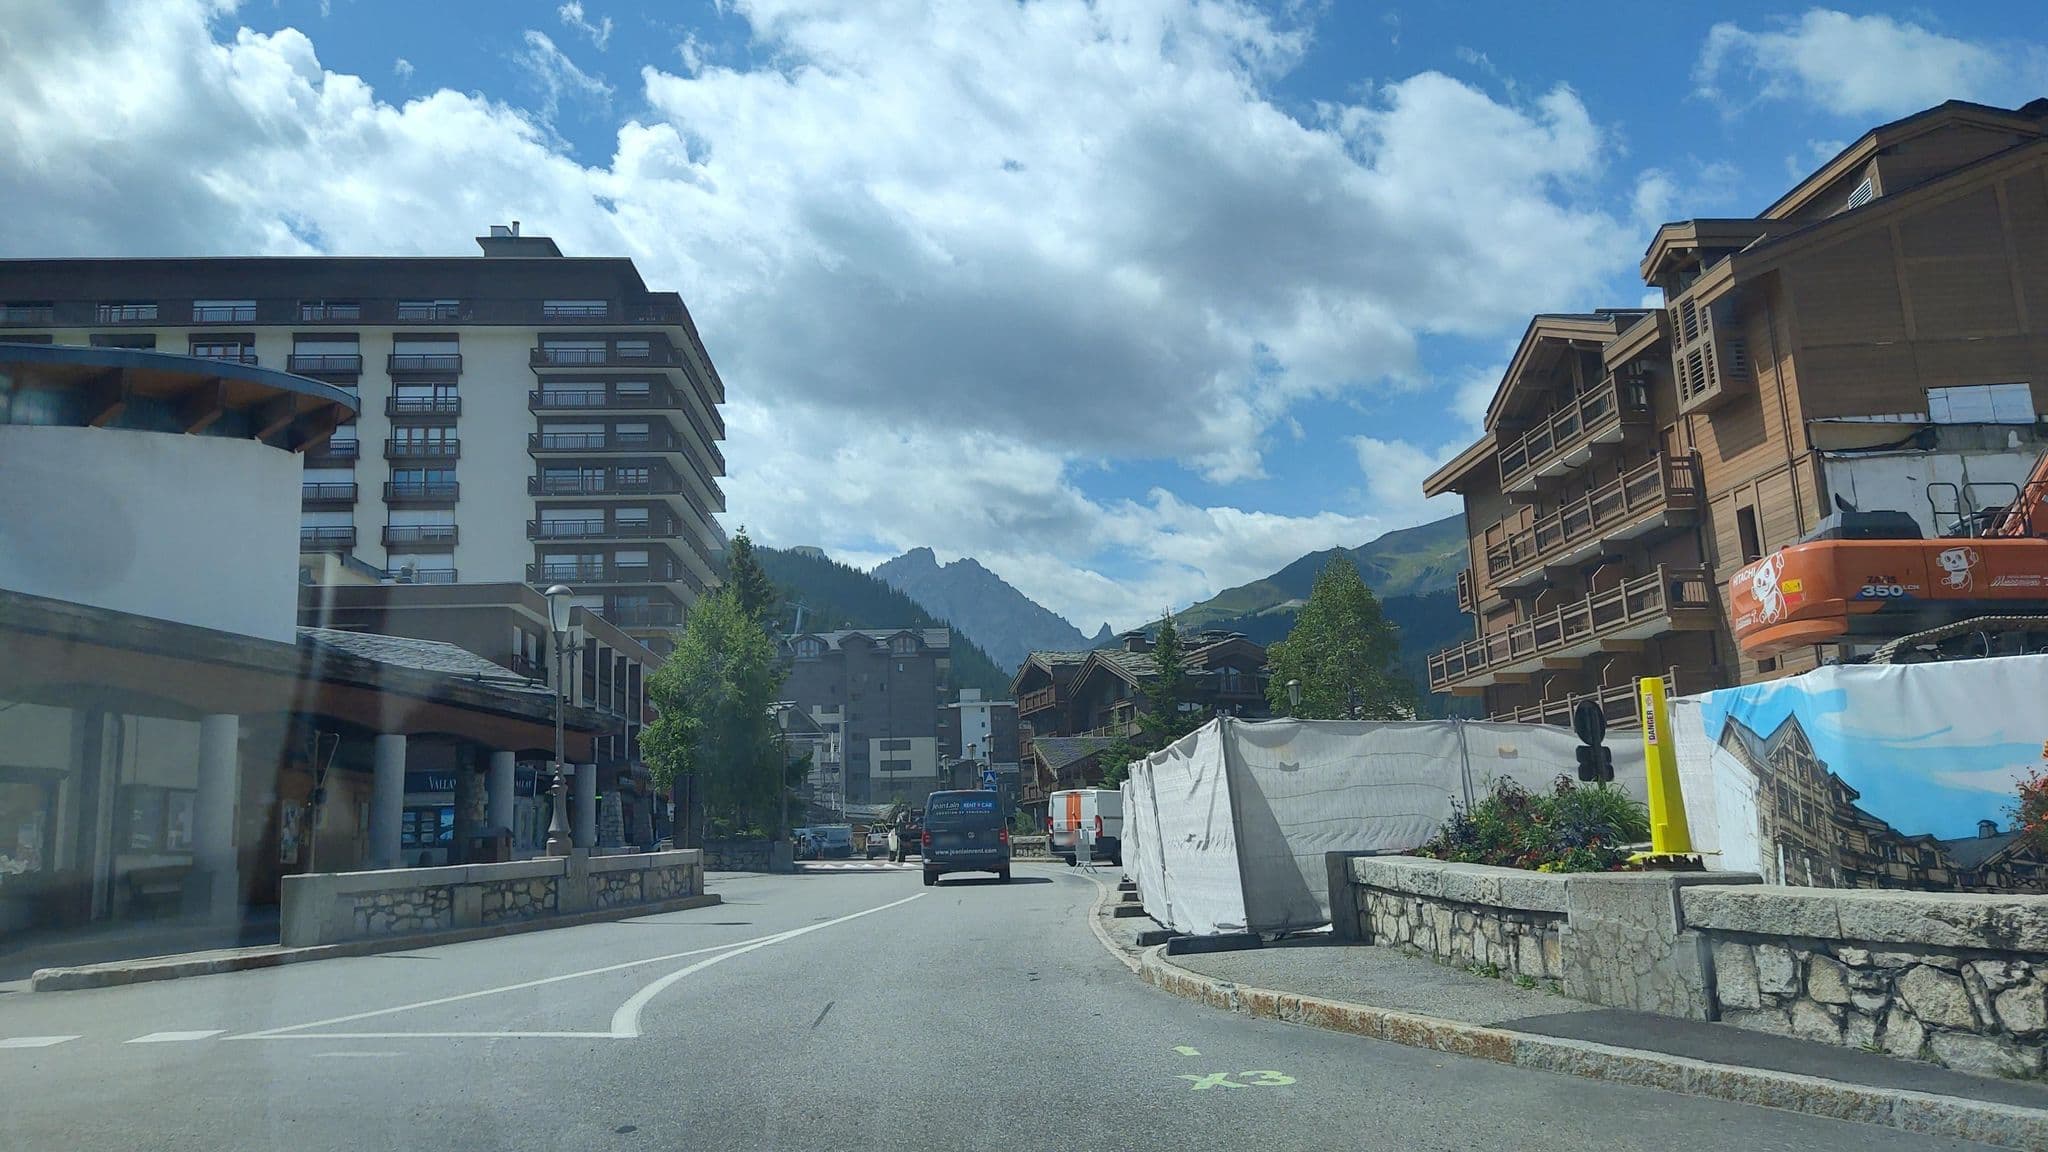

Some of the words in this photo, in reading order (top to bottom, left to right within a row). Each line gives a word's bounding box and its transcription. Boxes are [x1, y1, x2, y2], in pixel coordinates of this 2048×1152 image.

[1732, 567, 1756, 587] HITACHI
[1861, 584, 1904, 597] 350
[1646, 710, 1656, 741] DANGER
